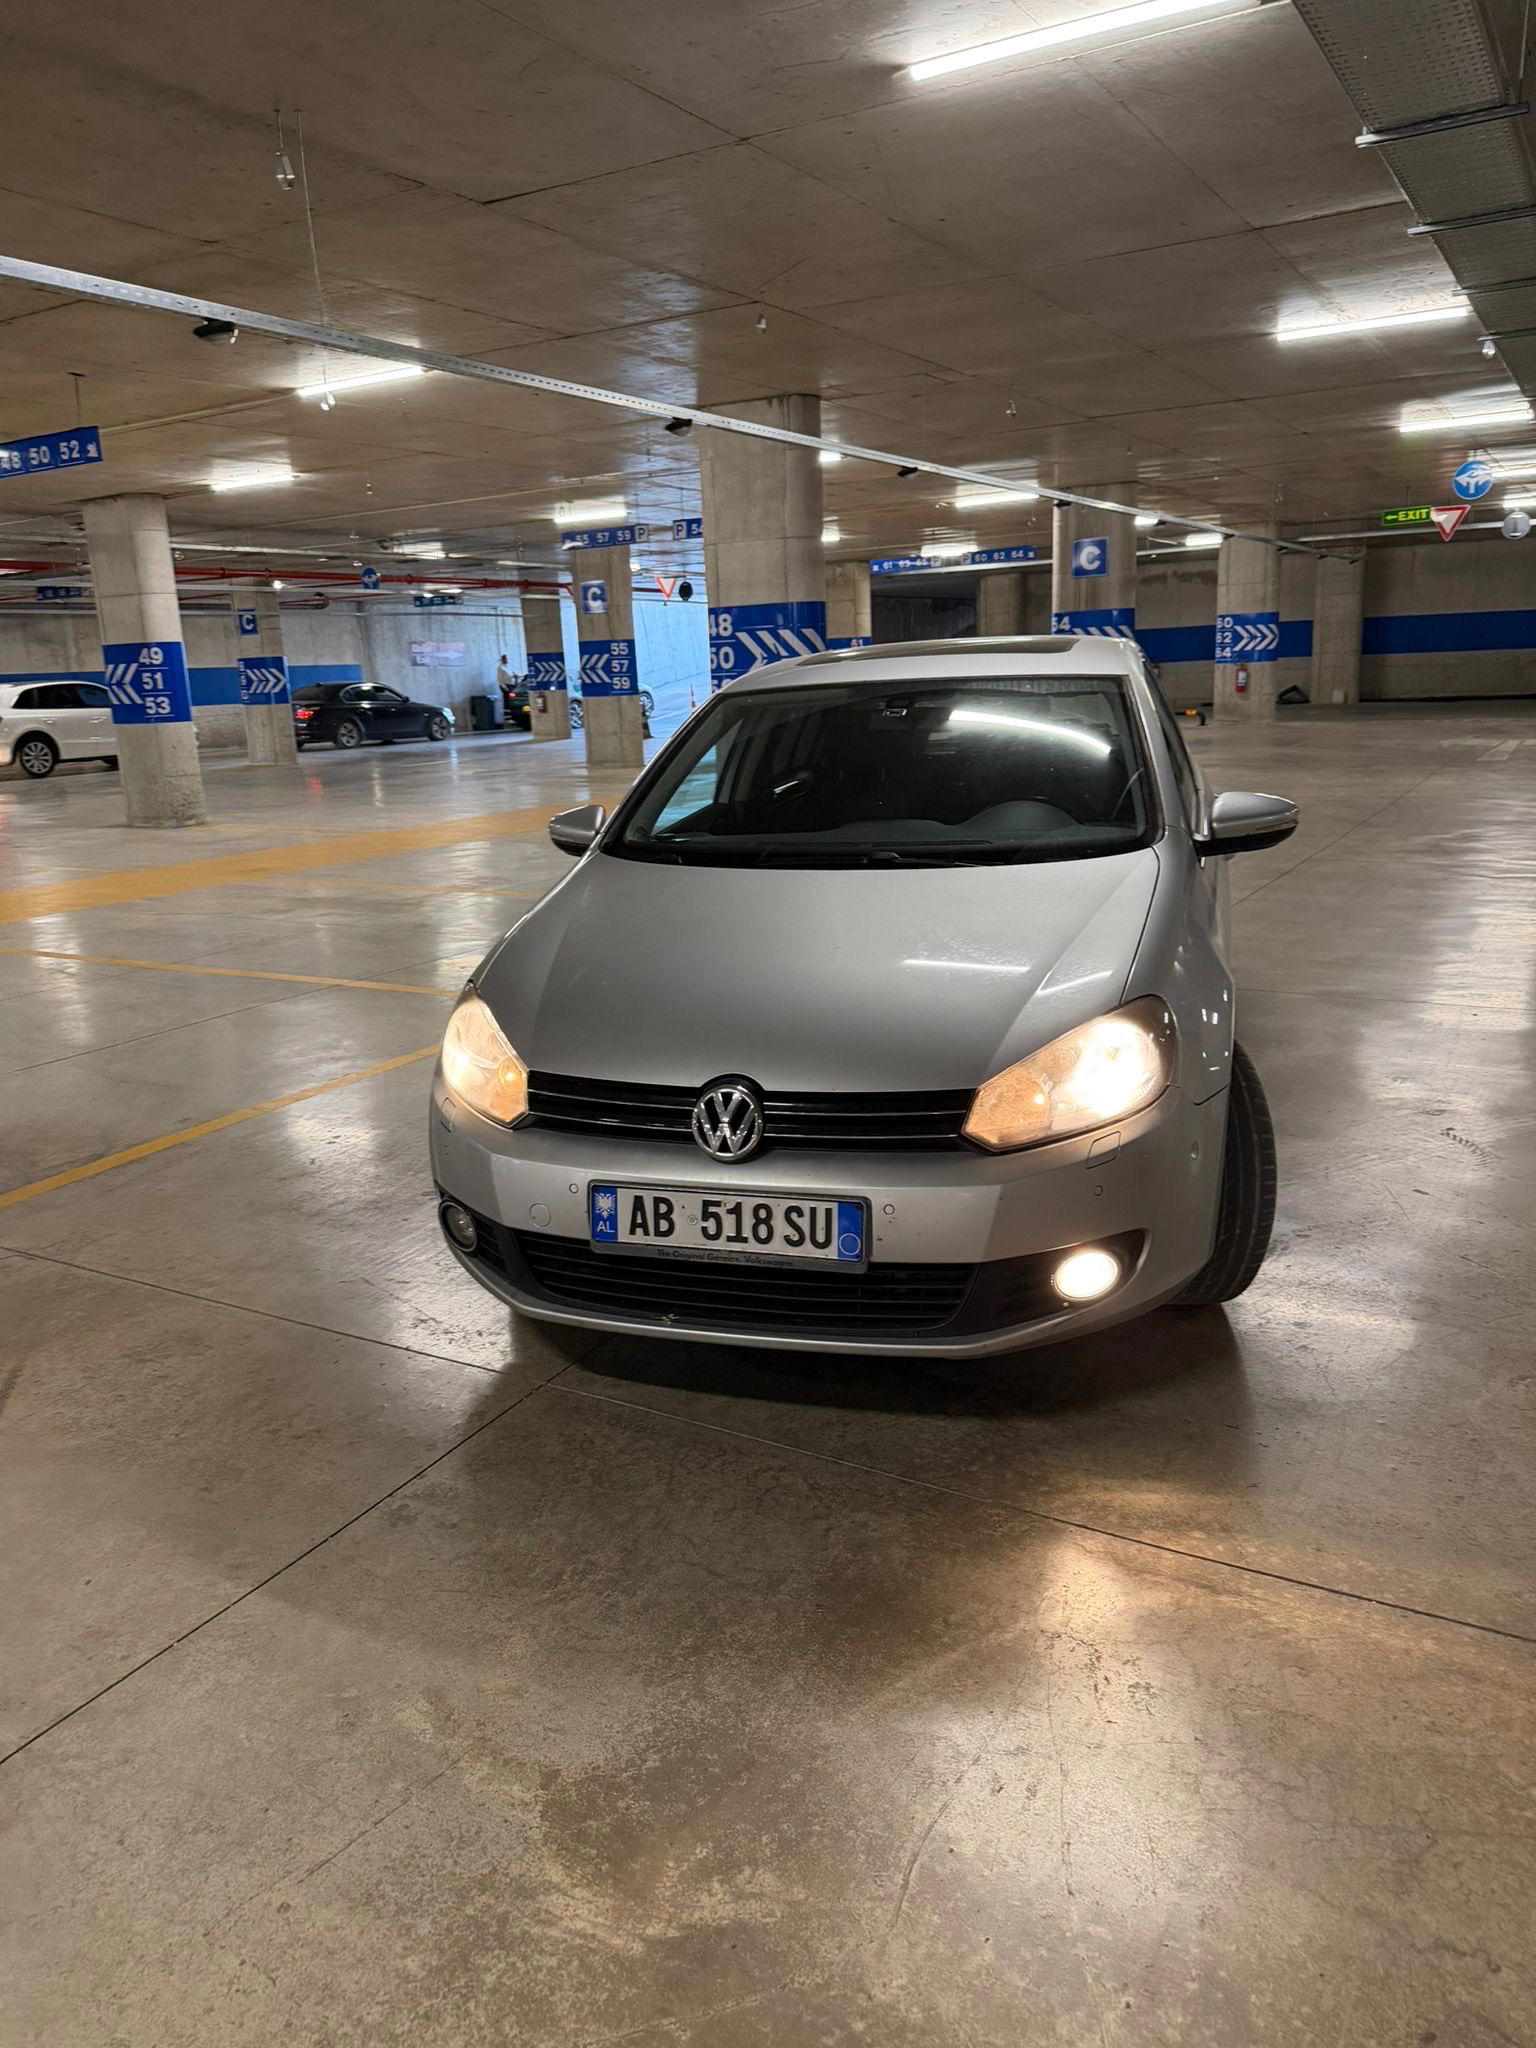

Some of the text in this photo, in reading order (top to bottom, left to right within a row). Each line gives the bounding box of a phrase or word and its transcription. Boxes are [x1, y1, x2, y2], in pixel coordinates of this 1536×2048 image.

[28, 445, 50, 466] 50
[59, 439, 80, 460] 52
[1397, 509, 1430, 521] EXIT
[596, 531, 610, 543] 57
[616, 529, 632, 541] 59
[993, 551, 1006, 560] 62
[1010, 550, 1025, 559] 64
[1079, 546, 1101, 571] C
[587, 587, 601, 608] C
[241, 614, 255, 630] C
[138, 647, 163, 665] 49
[610, 643, 629, 655] 55
[611, 660, 629, 672] 57
[142, 672, 164, 689] 51
[612, 677, 631, 689] 59
[144, 696, 171, 714] 53
[596, 1220, 615, 1233] AL
[629, 1195, 833, 1249] AB 518 SU
